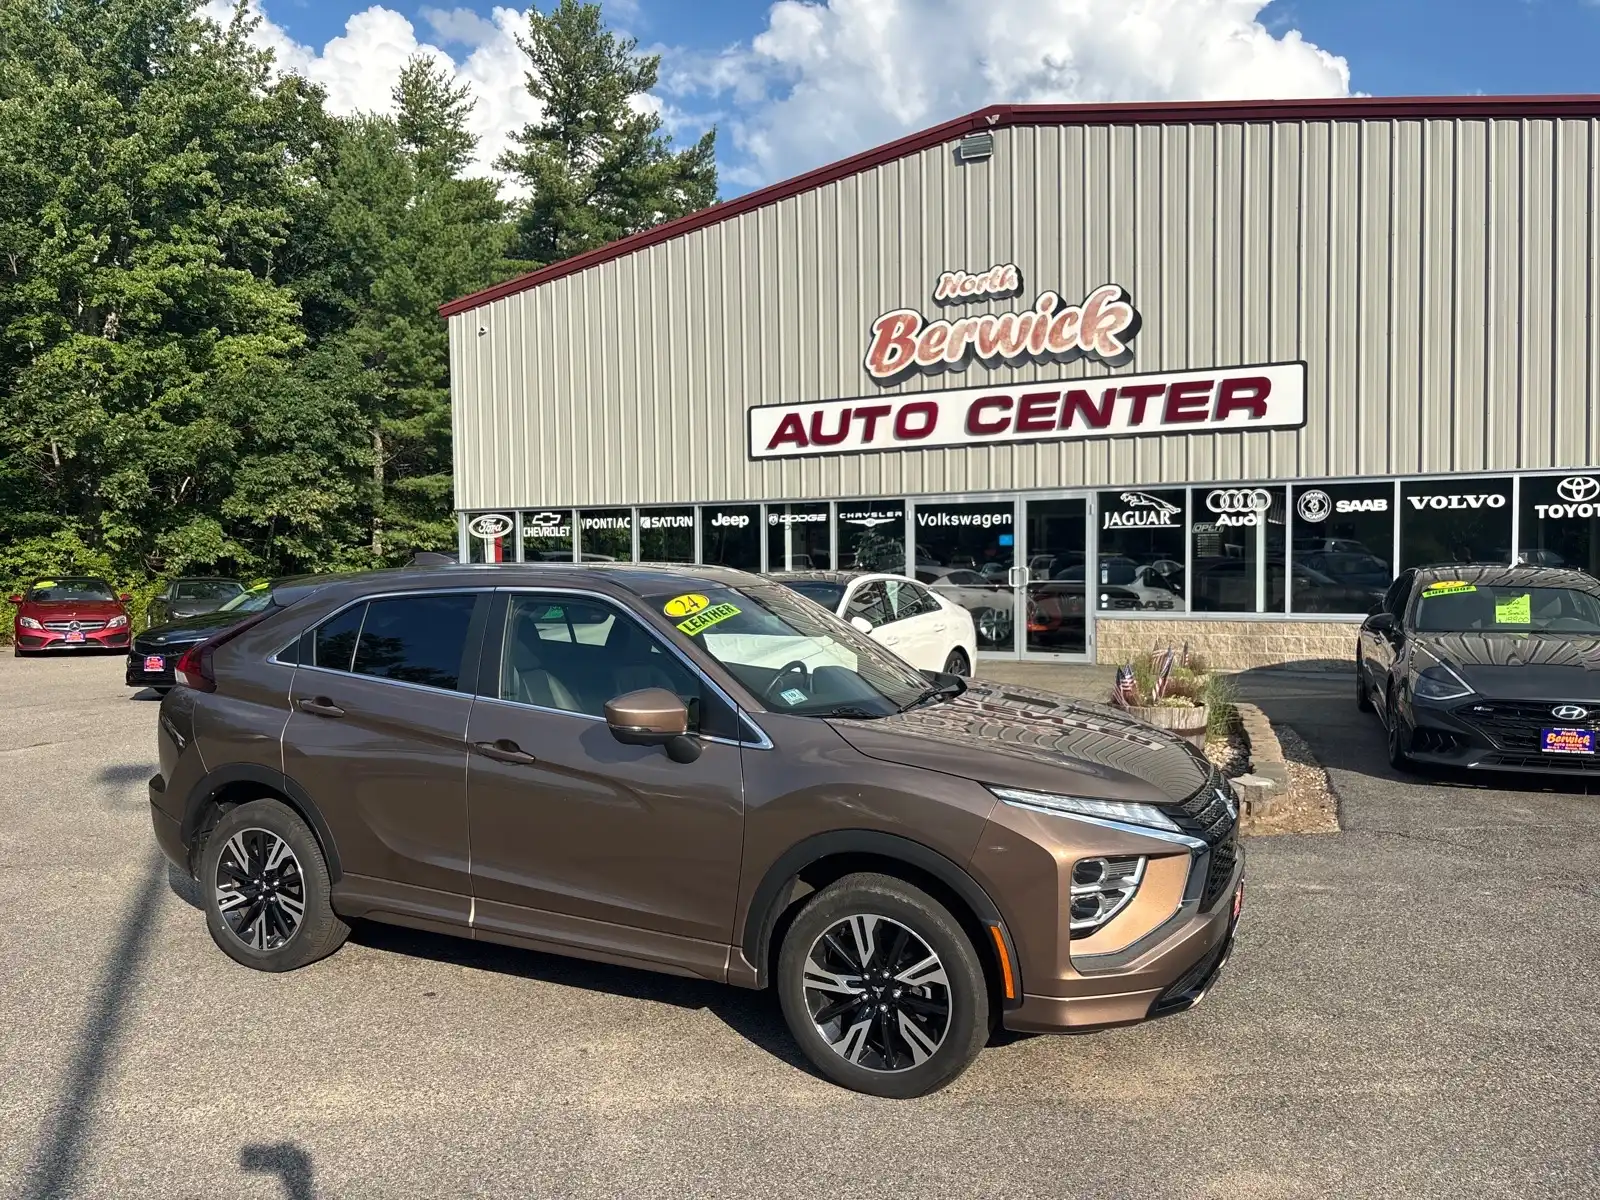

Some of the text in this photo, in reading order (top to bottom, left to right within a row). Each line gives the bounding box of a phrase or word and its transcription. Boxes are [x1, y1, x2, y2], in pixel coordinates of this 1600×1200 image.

[938, 265, 1018, 300] North
[868, 285, 1134, 377] Berwick
[766, 376, 1272, 451] AUTO CENTER
[1336, 499, 1388, 513] SAAB
[1407, 494, 1505, 510] VOLVO
[586, 517, 631, 530] PONTIAC
[651, 516, 693, 528] SATURN
[711, 512, 750, 528] Jeep
[779, 513, 827, 523] DODGE
[917, 513, 1012, 528] Volkswagen
[1103, 510, 1171, 529] JAGUAR
[1215, 513, 1262, 527] Audi
[478, 519, 503, 534] Ford
[523, 526, 571, 537] CHEVROLET
[675, 595, 700, 613] 24
[682, 604, 735, 632] LEATHER
[1546, 732, 1591, 746] Berwick
